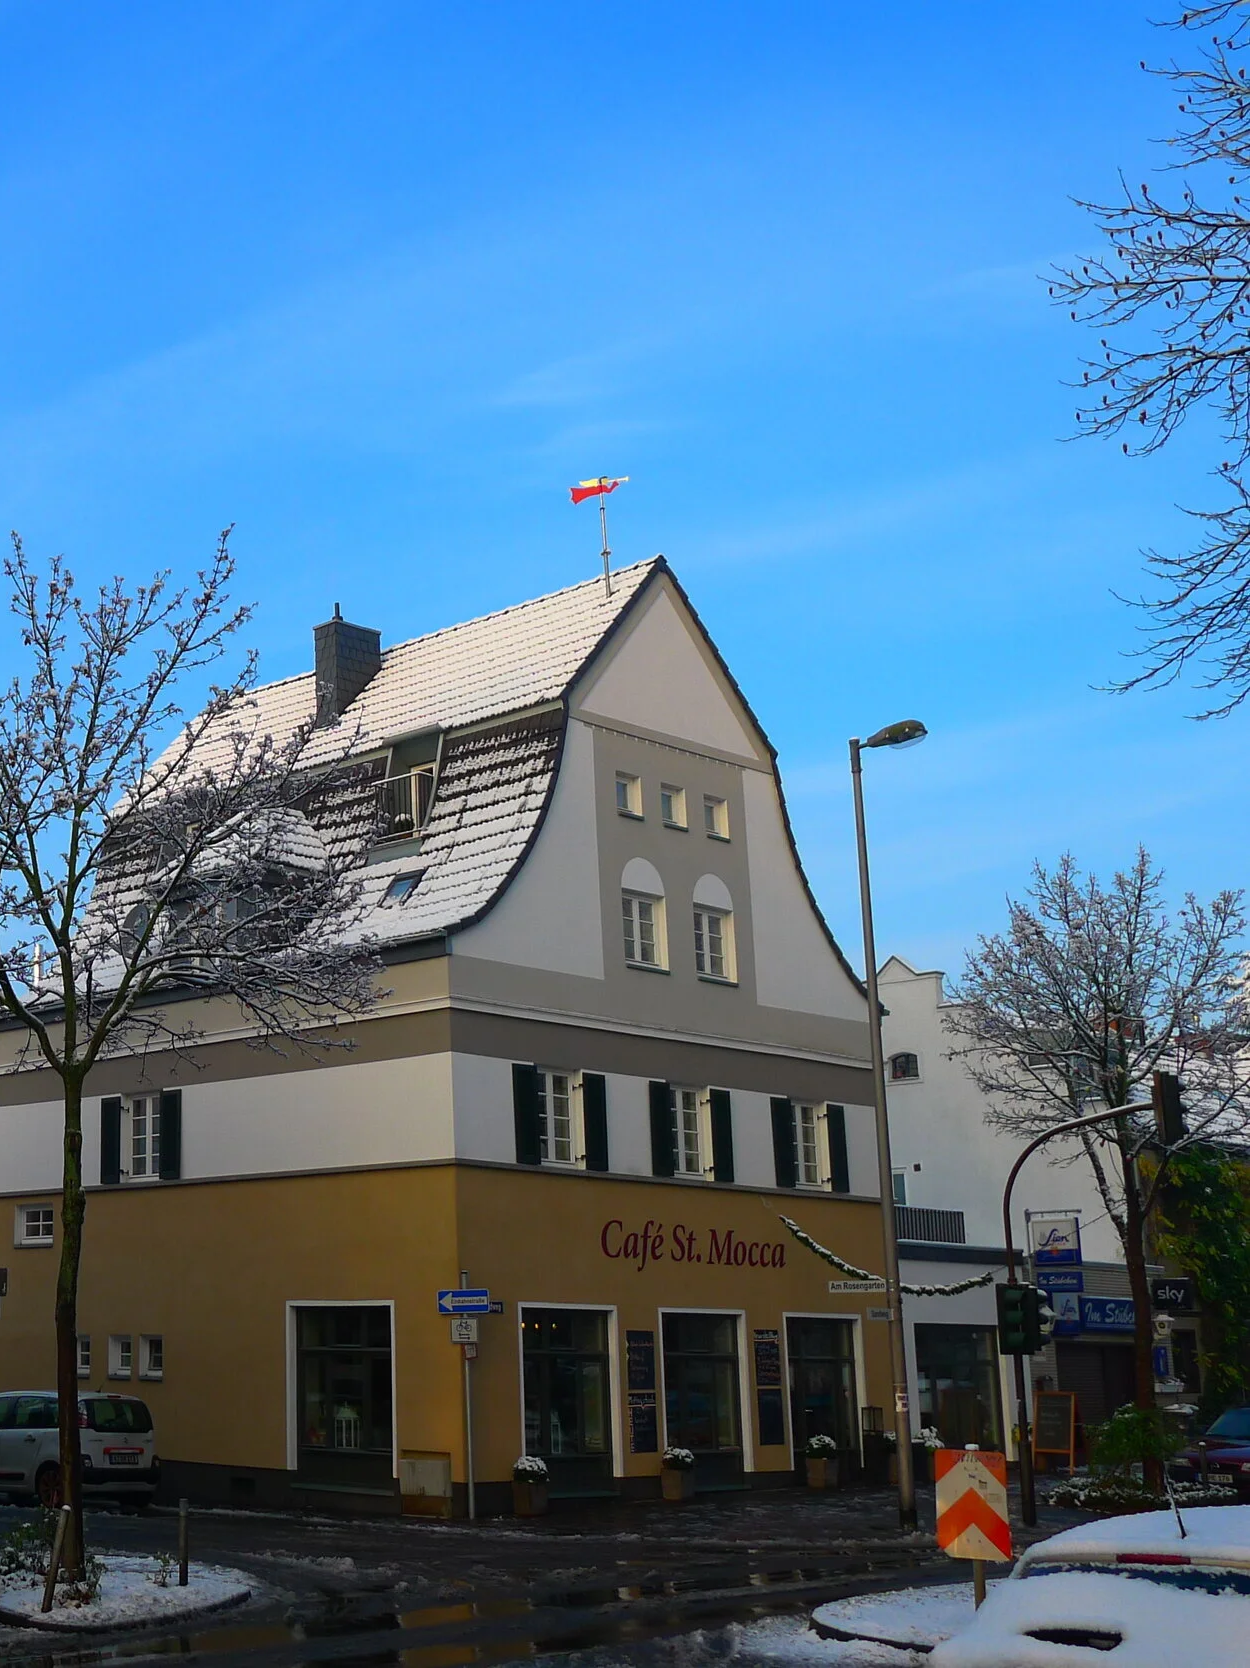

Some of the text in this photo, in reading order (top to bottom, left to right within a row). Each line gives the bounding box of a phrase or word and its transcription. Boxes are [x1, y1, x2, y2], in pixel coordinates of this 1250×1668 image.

[601, 1220, 786, 1272] Café St. Mocca
[830, 1281, 886, 1292] Am Rosengarten
[1157, 1284, 1185, 1303] sky
